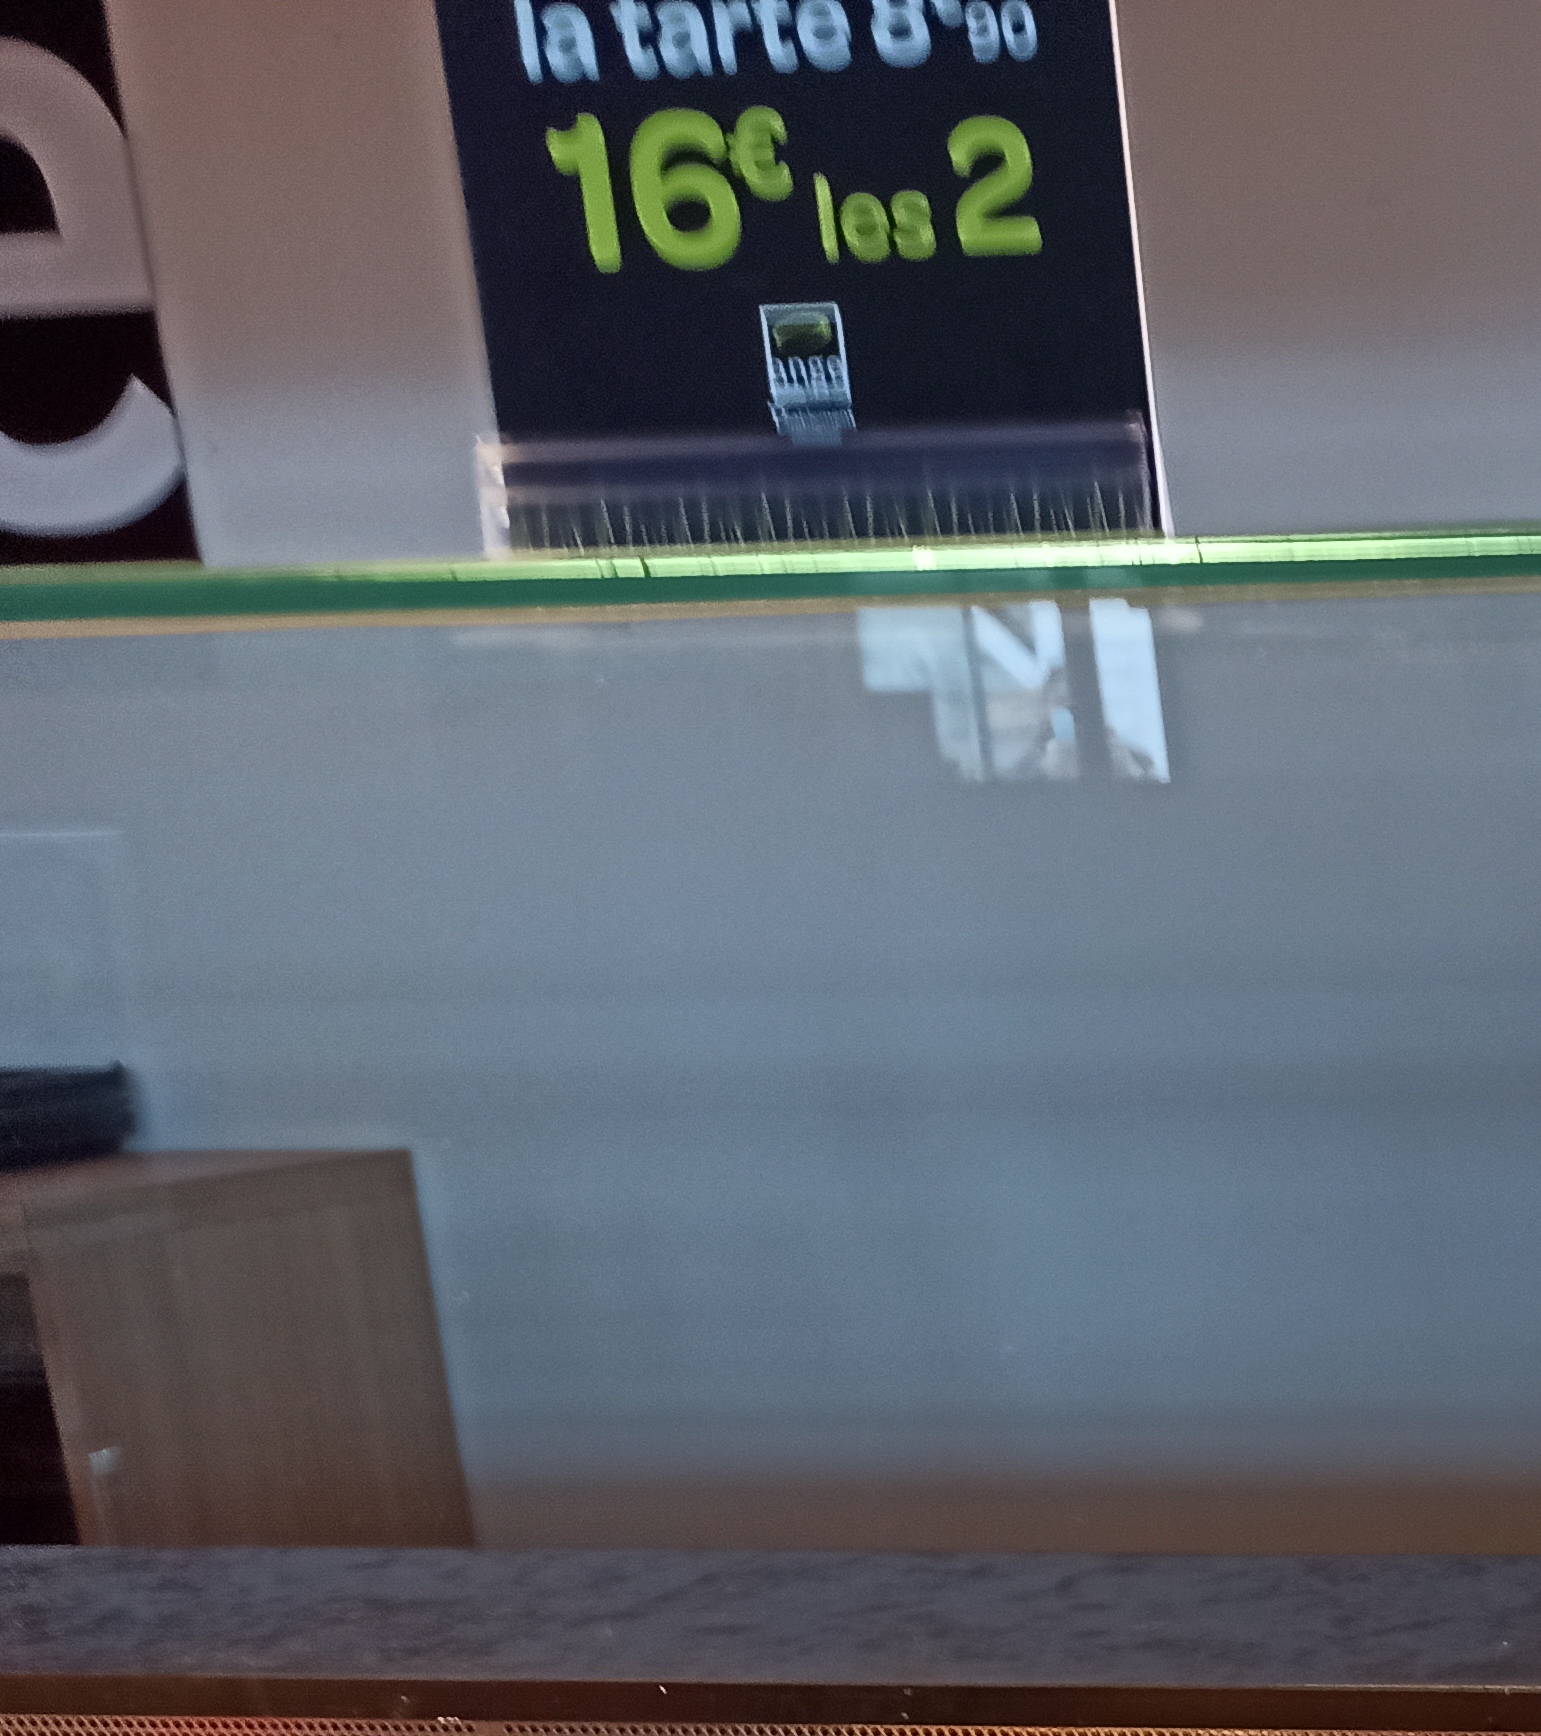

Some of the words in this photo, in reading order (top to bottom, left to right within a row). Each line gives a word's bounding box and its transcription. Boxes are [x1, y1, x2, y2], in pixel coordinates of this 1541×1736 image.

[514, 0, 600, 84] la
[609, 0, 852, 81] tarte
[545, 106, 794, 273] 16€
[812, 171, 937, 264] les
[947, 114, 1043, 256] 2
